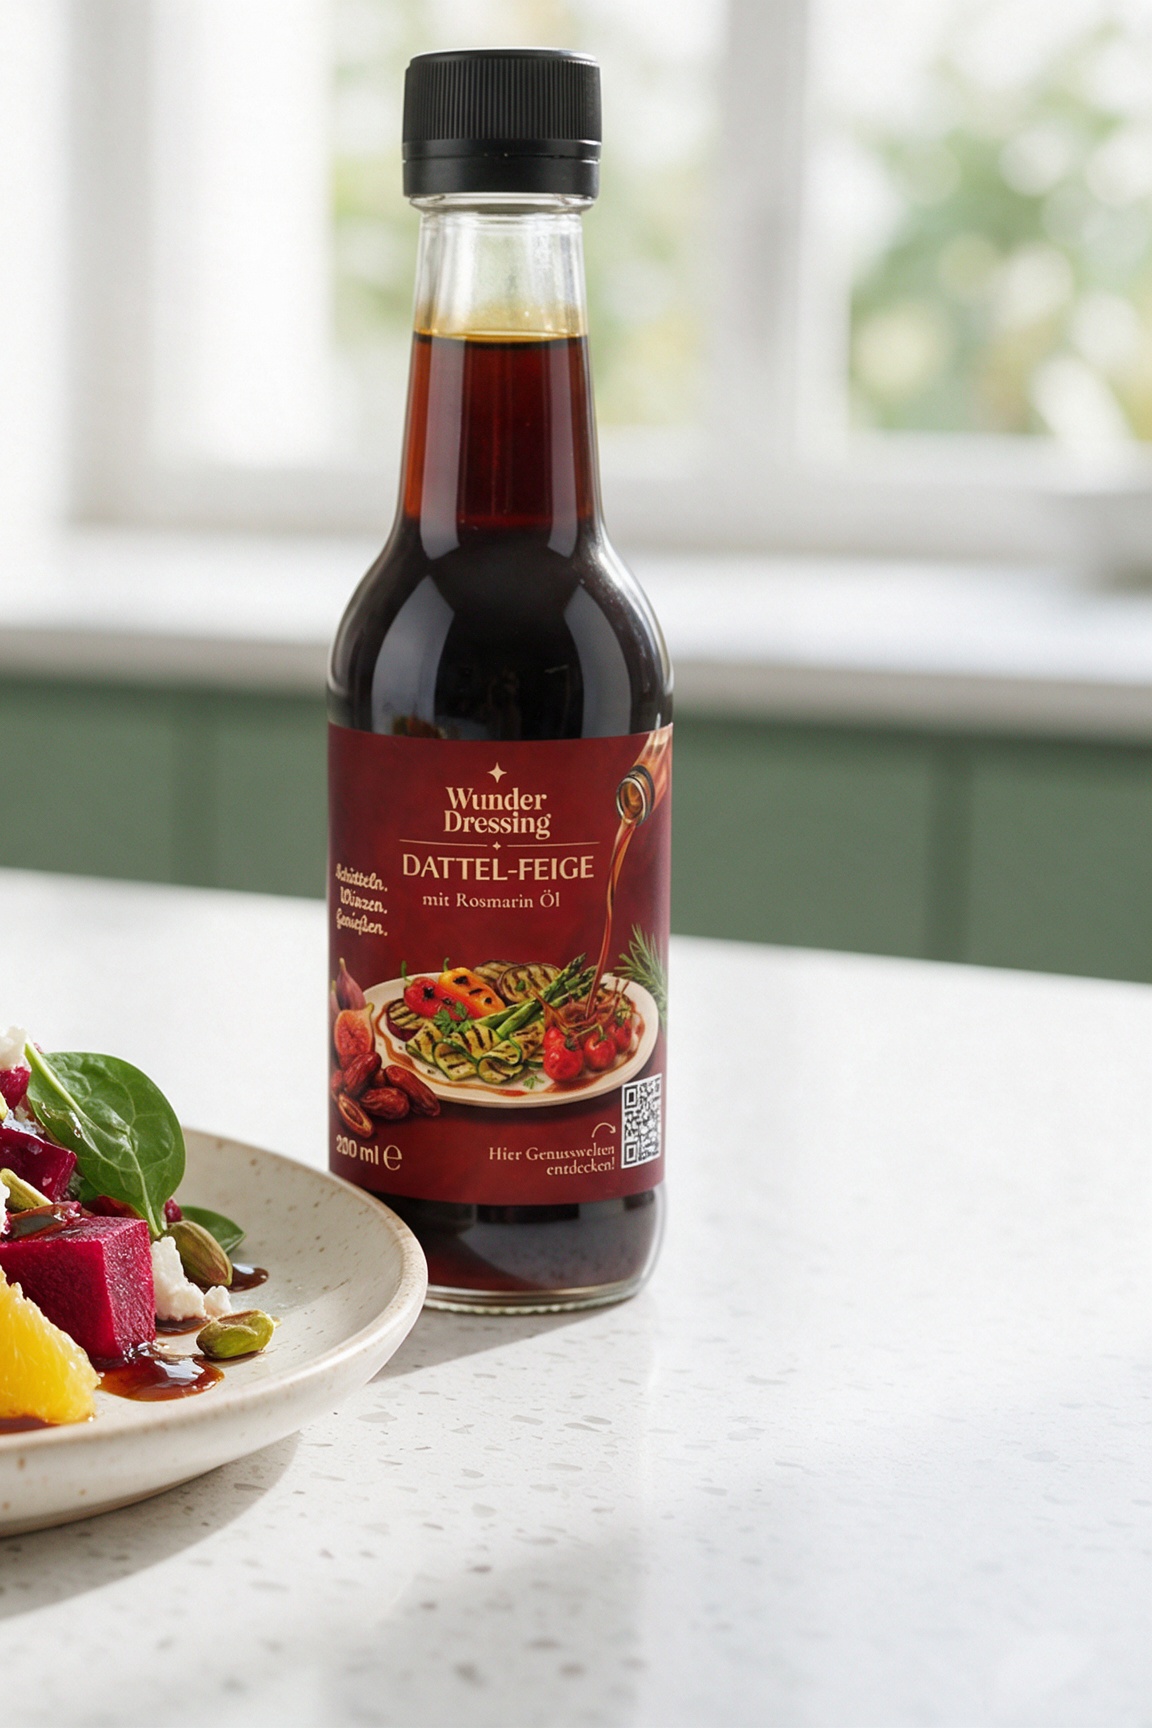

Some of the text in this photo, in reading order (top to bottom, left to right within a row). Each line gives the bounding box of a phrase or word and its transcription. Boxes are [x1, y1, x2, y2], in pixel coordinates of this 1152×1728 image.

[445, 787, 548, 811] Wunder
[443, 810, 552, 840] Dressing
[403, 853, 595, 881] DATTEL-FEIGE
[423, 889, 560, 908] mit Rosmarin Öl
[336, 1134, 358, 1158] 200
[359, 1145, 380, 1166] ml
[489, 1147, 522, 1161] Hier
[546, 1156, 615, 1176] entdecken!
